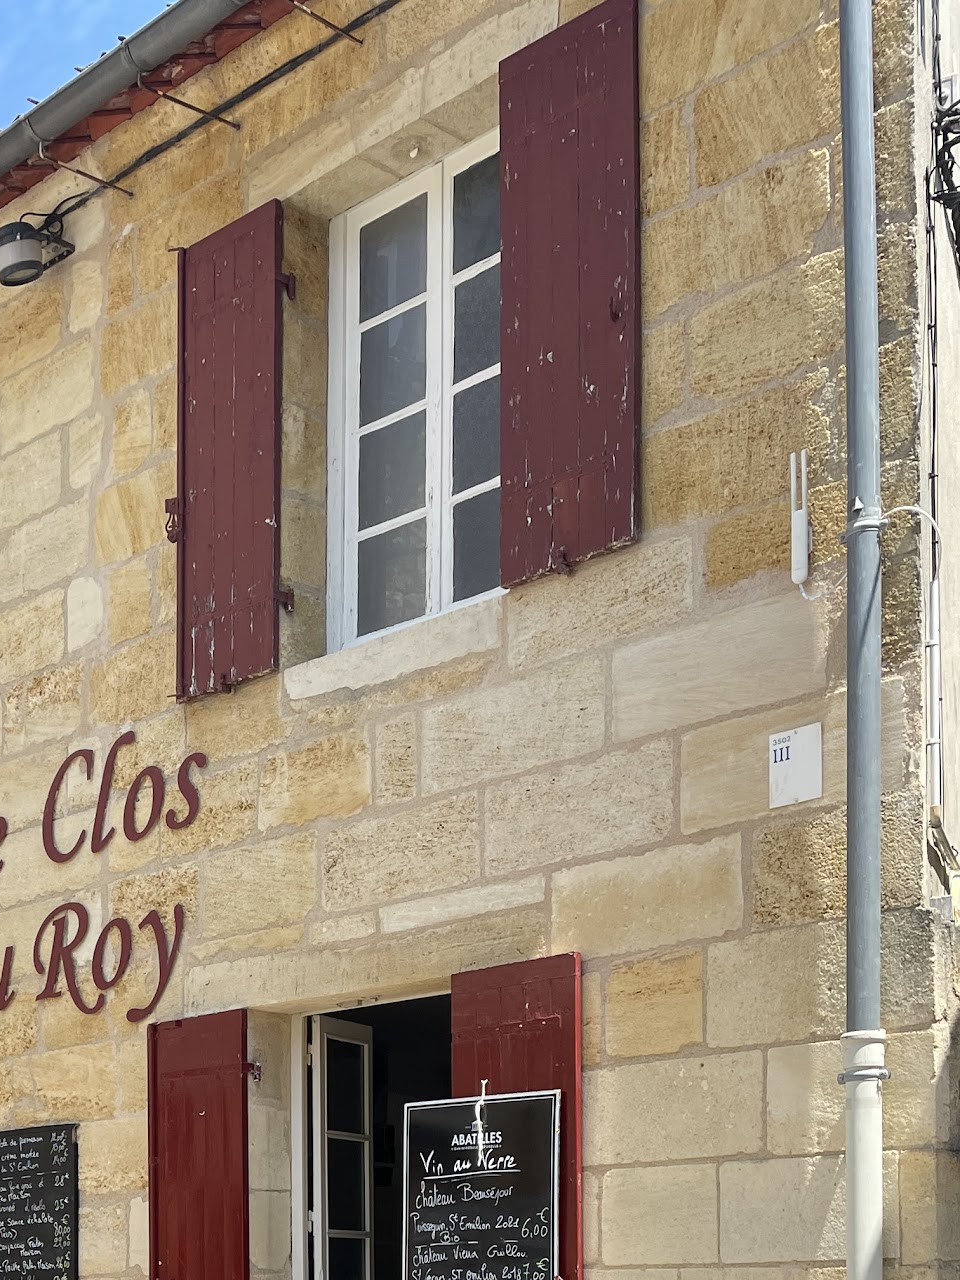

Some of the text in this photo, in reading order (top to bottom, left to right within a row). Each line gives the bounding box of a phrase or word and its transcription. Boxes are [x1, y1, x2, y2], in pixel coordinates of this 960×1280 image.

[773, 736, 791, 746] 3502
[42, 730, 208, 863] Clos
[33, 902, 185, 1023] Roy
[420, 1150, 444, 1176] Vin
[454, 1159, 472, 1172] au
[440, 1231, 461, 1243] Bio
